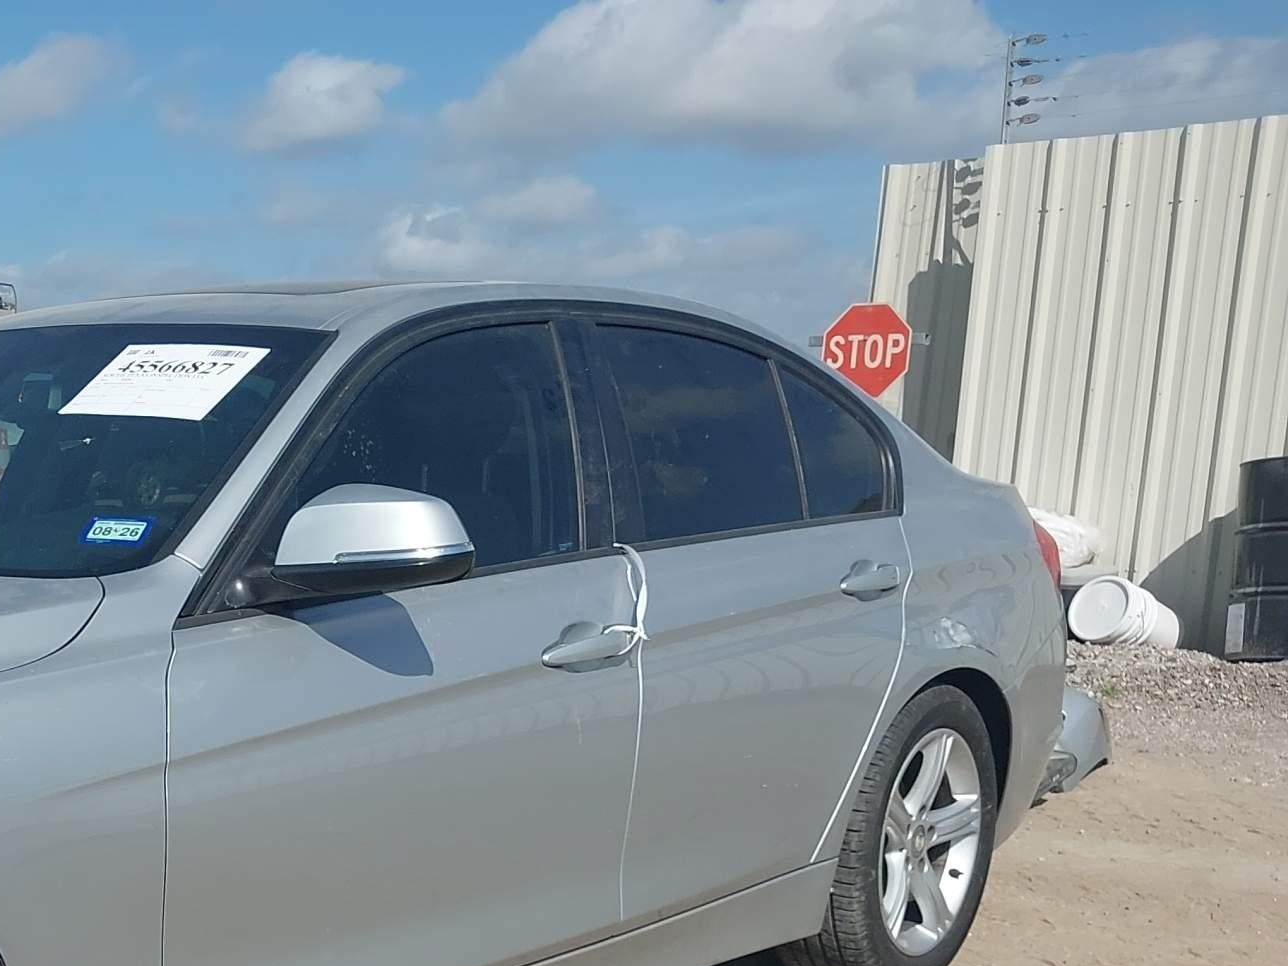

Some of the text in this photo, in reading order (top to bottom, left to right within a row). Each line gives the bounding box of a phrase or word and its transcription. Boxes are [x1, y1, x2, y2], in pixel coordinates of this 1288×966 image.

[826, 333, 905, 369] STOP
[118, 360, 235, 376] 45566827
[92, 526, 141, 537] 08 26
